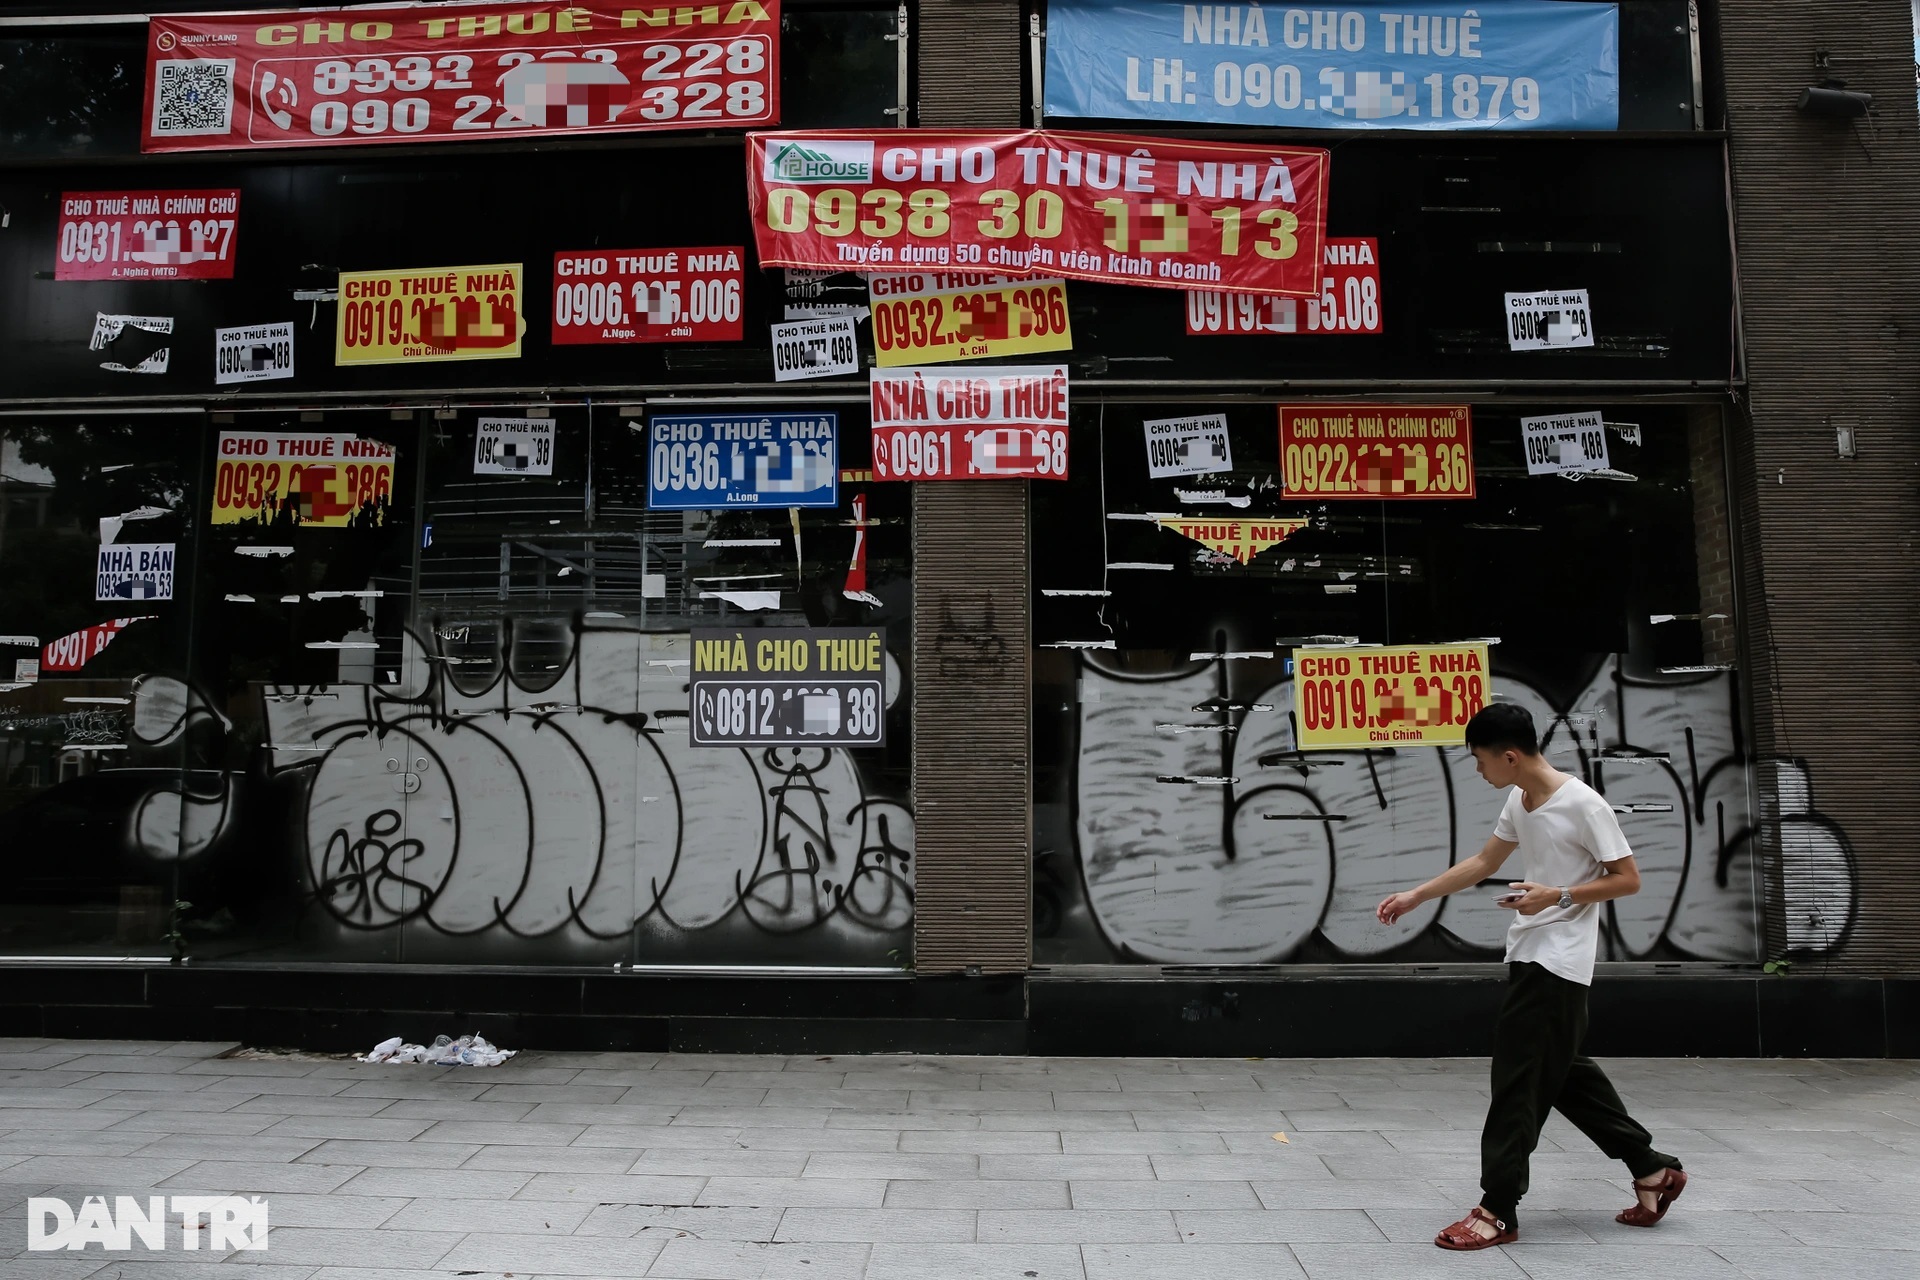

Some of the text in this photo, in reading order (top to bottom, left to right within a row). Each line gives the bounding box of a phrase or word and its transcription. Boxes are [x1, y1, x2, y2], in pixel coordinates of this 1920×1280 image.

[181, 34, 211, 43] SUNNY
[255, 21, 394, 46] CHO
[418, 7, 593, 39] THUÊ
[1183, 2, 1482, 58] NHÀ CHO THUÊ
[1126, 56, 1196, 105] LH:
[310, 97, 430, 136] 090
[806, 162, 869, 176] HOUSE
[881, 146, 1297, 204] CHO THUÊ NHÀ
[64, 192, 237, 217] CHO THUÊ NHÀ CHÍNH CHỦ
[766, 187, 950, 238] 0938
[977, 189, 1064, 239] 30
[557, 250, 741, 276] CHO THUÊ NHÀ
[836, 239, 1221, 282] Tuyển dụng 50 chuyên viên kinh doanh
[1324, 240, 1375, 266] NHÀ
[111, 268, 121, 277] A.
[151, 267, 178, 277] (MTG)
[345, 269, 516, 299] CHO THUÊ NHÀ
[872, 274, 924, 296] CHO
[1511, 292, 1583, 307] CHO THUÊ NHÀ
[221, 325, 289, 342] CHO THUÊ NHÀ
[777, 319, 849, 338] CHO THUÊ NHÀ
[959, 347, 969, 357] A.
[872, 368, 1067, 422] NHÀ CHO THUÊ
[482, 421, 550, 433] CHO THUÊ NHÀ
[654, 417, 833, 442] CHO THUÊ NHÀ
[1150, 416, 1222, 434] CHO THUÊ NHÀ
[1293, 417, 1319, 439] CHO
[1321, 413, 1354, 438] THUÊ
[1357, 413, 1385, 438] NHÀ
[1388, 413, 1427, 438] CHÍNH
[1431, 410, 1457, 438] CHỦ
[1527, 415, 1598, 431] CHO THUÊ NHÀ
[221, 438, 268, 456] CHO
[276, 436, 335, 457] THUÊ
[891, 430, 951, 476] 0961
[726, 492, 759, 503] A.Long
[1179, 522, 1242, 540] THUÊ
[99, 545, 173, 572] NHÀ BÁN
[47, 630, 88, 667] 0901
[695, 632, 881, 672] NHÀ CHO THUÊ
[1300, 649, 1482, 677] CHO THUÊ NHÀ
[716, 687, 775, 736] 0812
[1369, 729, 1390, 741] Chú
